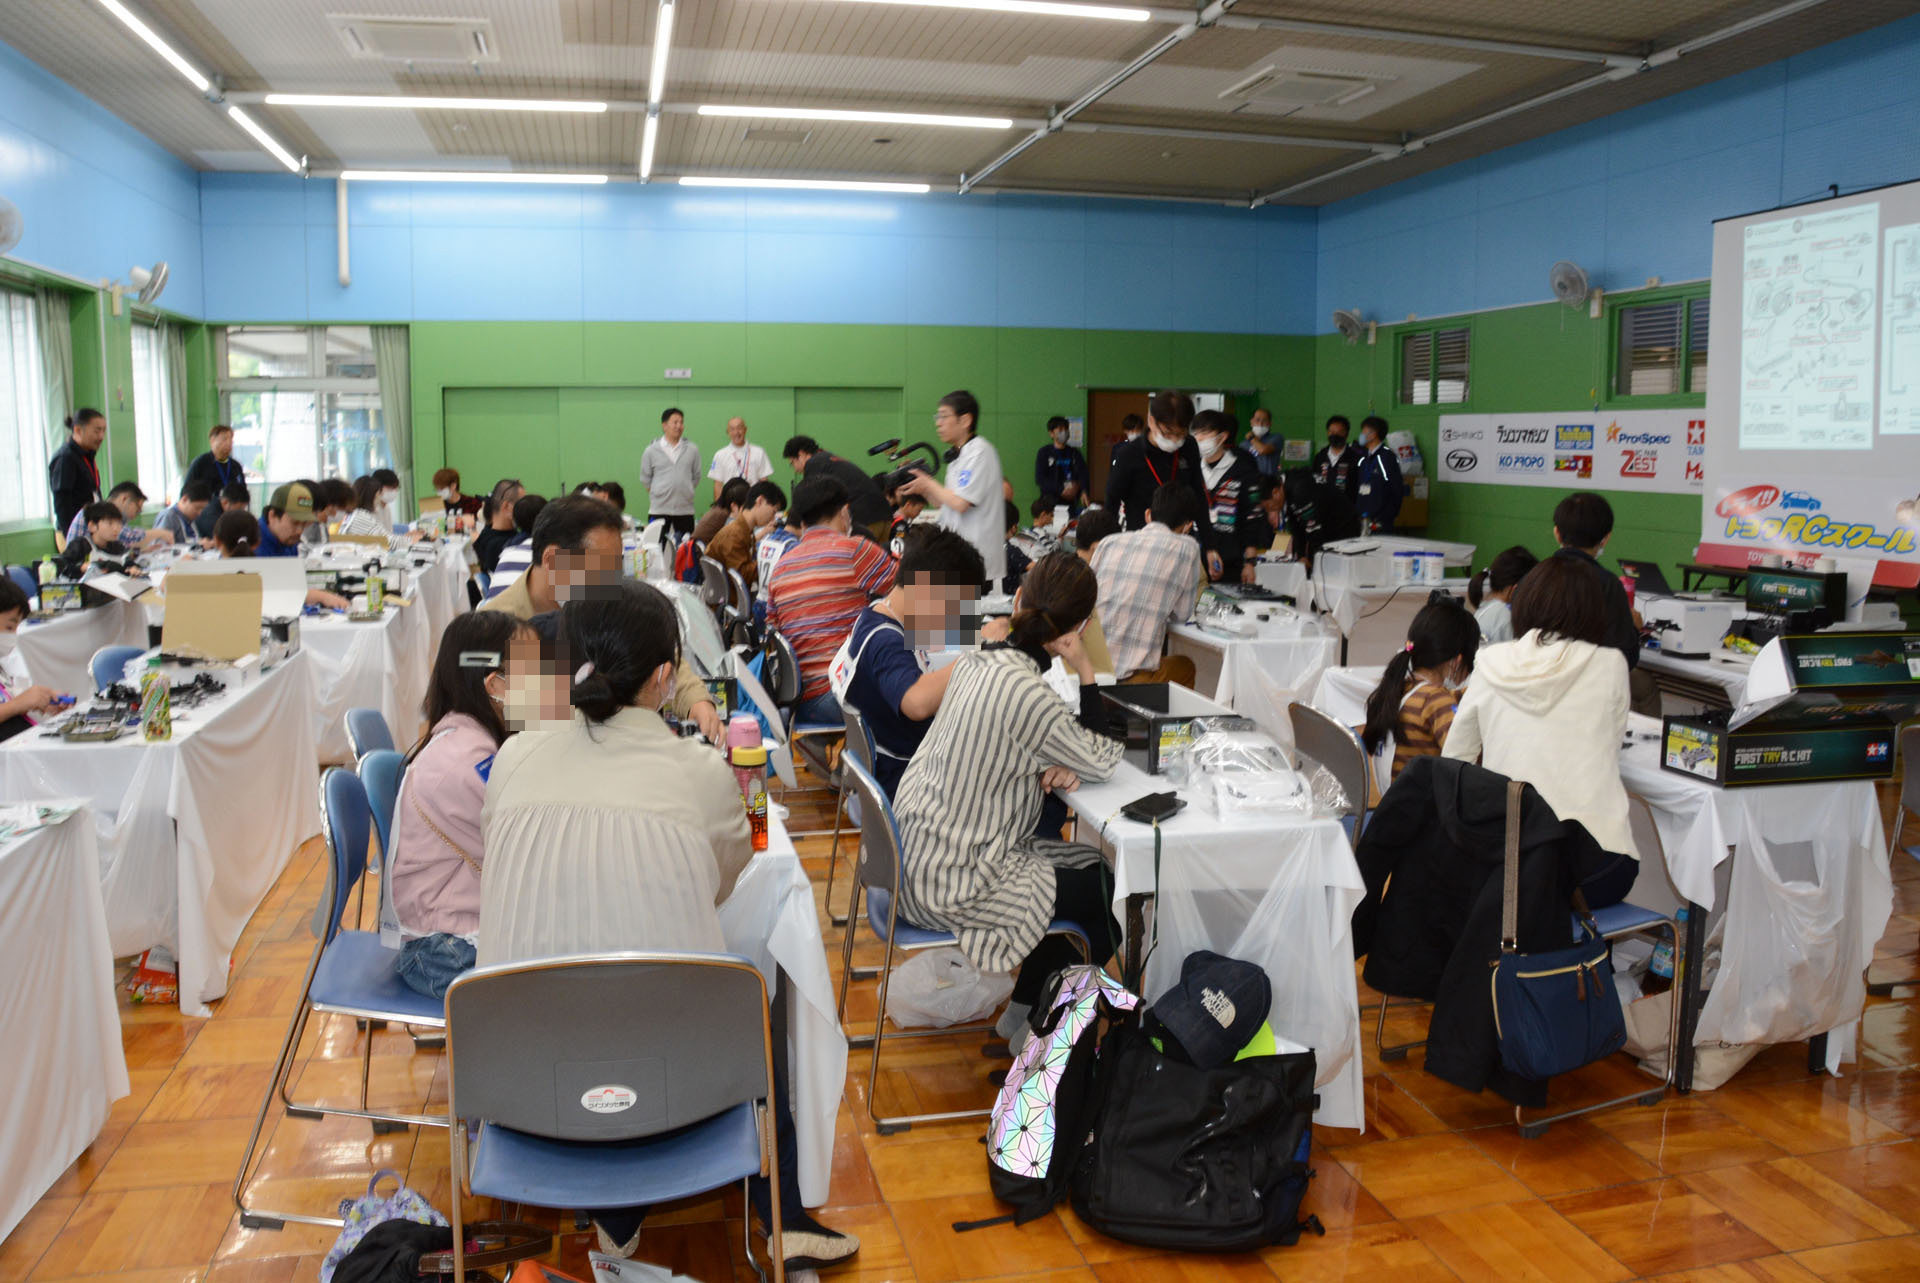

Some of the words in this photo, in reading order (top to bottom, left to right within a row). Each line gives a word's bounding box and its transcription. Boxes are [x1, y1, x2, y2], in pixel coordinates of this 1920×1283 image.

[1726, 513, 1917, 553] トヨタRCスクール
[1734, 752, 1762, 765] FIRST
[1763, 751, 1781, 764] TRY
[1797, 749, 1813, 762] KIT
[1200, 986, 1225, 1015] NORTH
